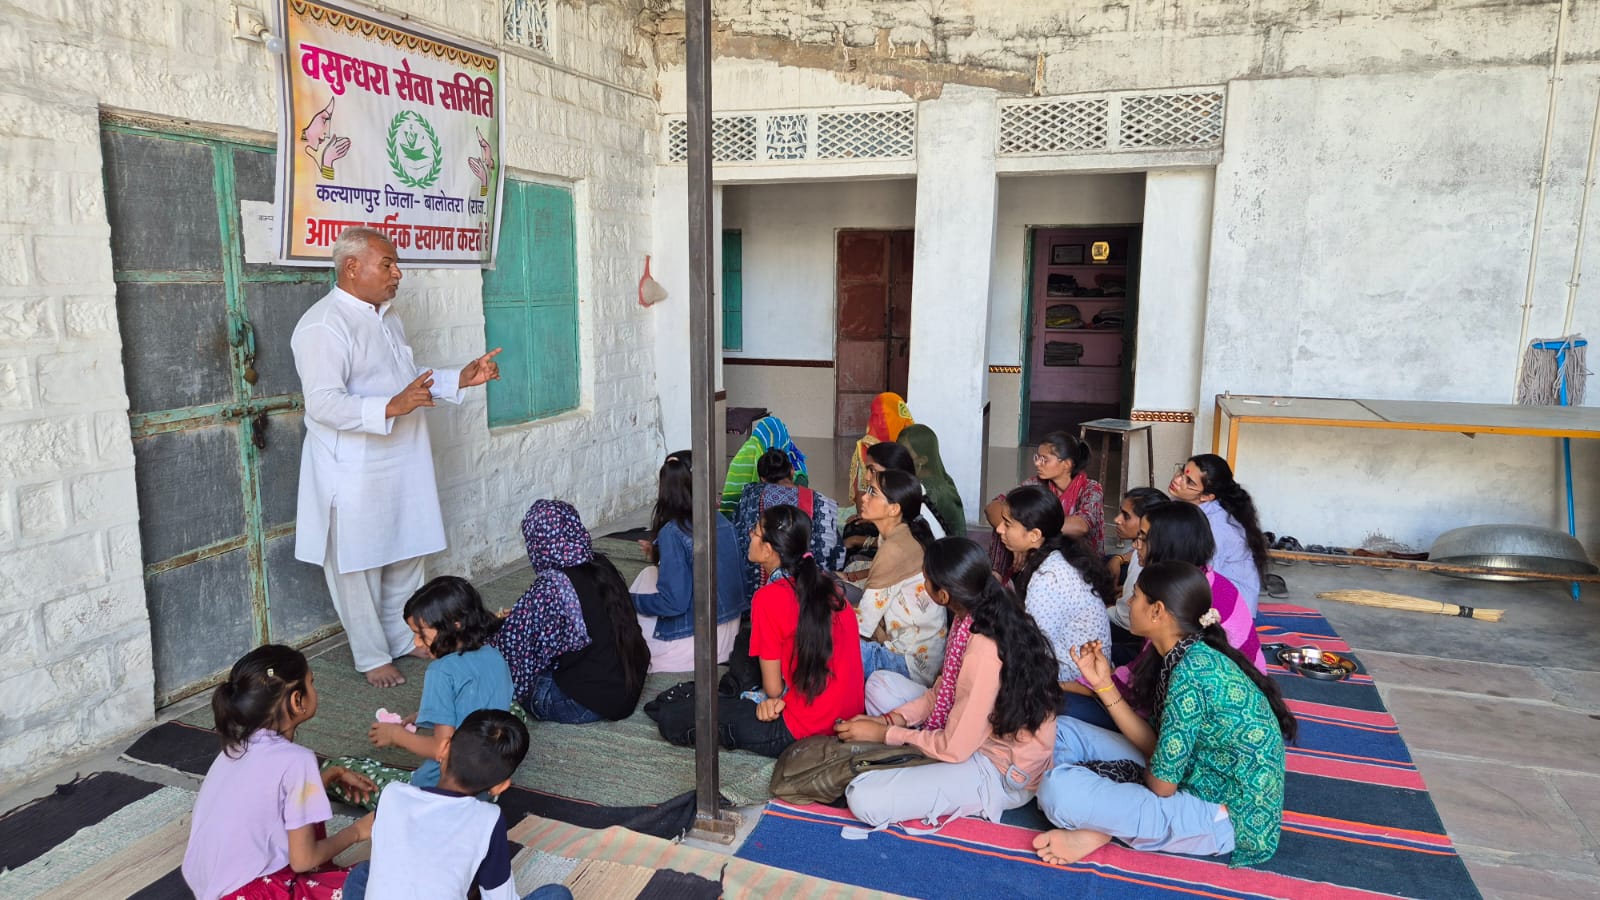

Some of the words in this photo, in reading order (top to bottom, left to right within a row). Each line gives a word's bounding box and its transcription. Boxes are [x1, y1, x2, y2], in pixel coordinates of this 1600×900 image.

[300, 43, 390, 96] वसुन्धरा
[393, 58, 435, 106] सेवा
[437, 72, 494, 118] समिति
[316, 184, 381, 213] कल्याणपुर
[424, 189, 465, 213] बालोतरा
[305, 218, 366, 247] आप
[413, 224, 455, 250] स्वागत
